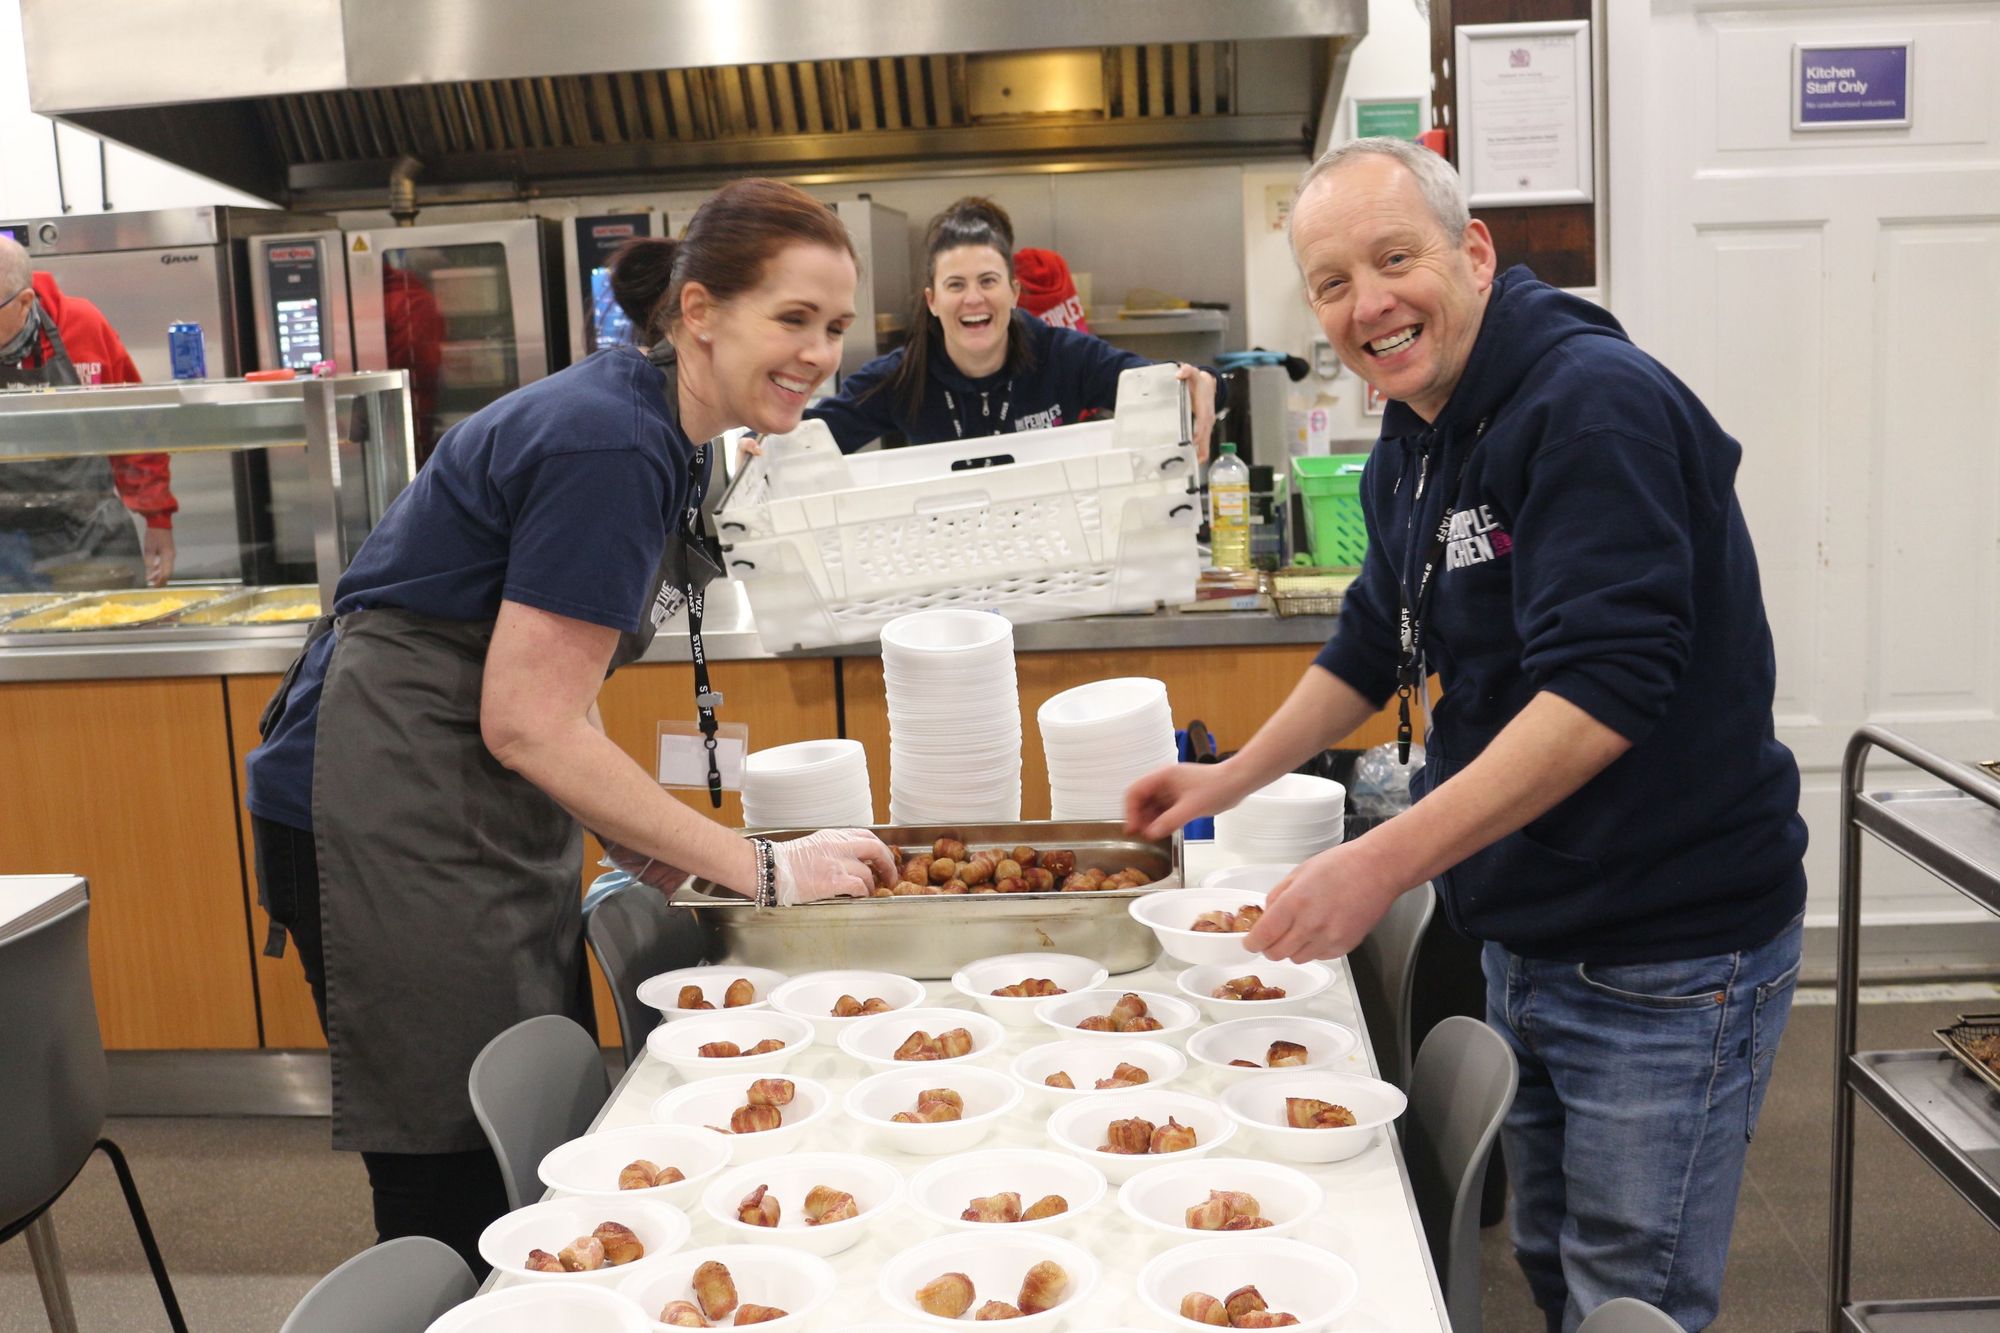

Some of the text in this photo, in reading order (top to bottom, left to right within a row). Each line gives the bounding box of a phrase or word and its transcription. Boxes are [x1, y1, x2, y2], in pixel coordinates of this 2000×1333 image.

[1806, 66, 1855, 79] Kitchen
[1806, 80, 1868, 95] Staff Only
[696, 445, 704, 464] STA
[687, 583, 696, 615] STAFF
[1401, 608, 1410, 636] TAFF
[692, 633, 704, 665] STAFF
